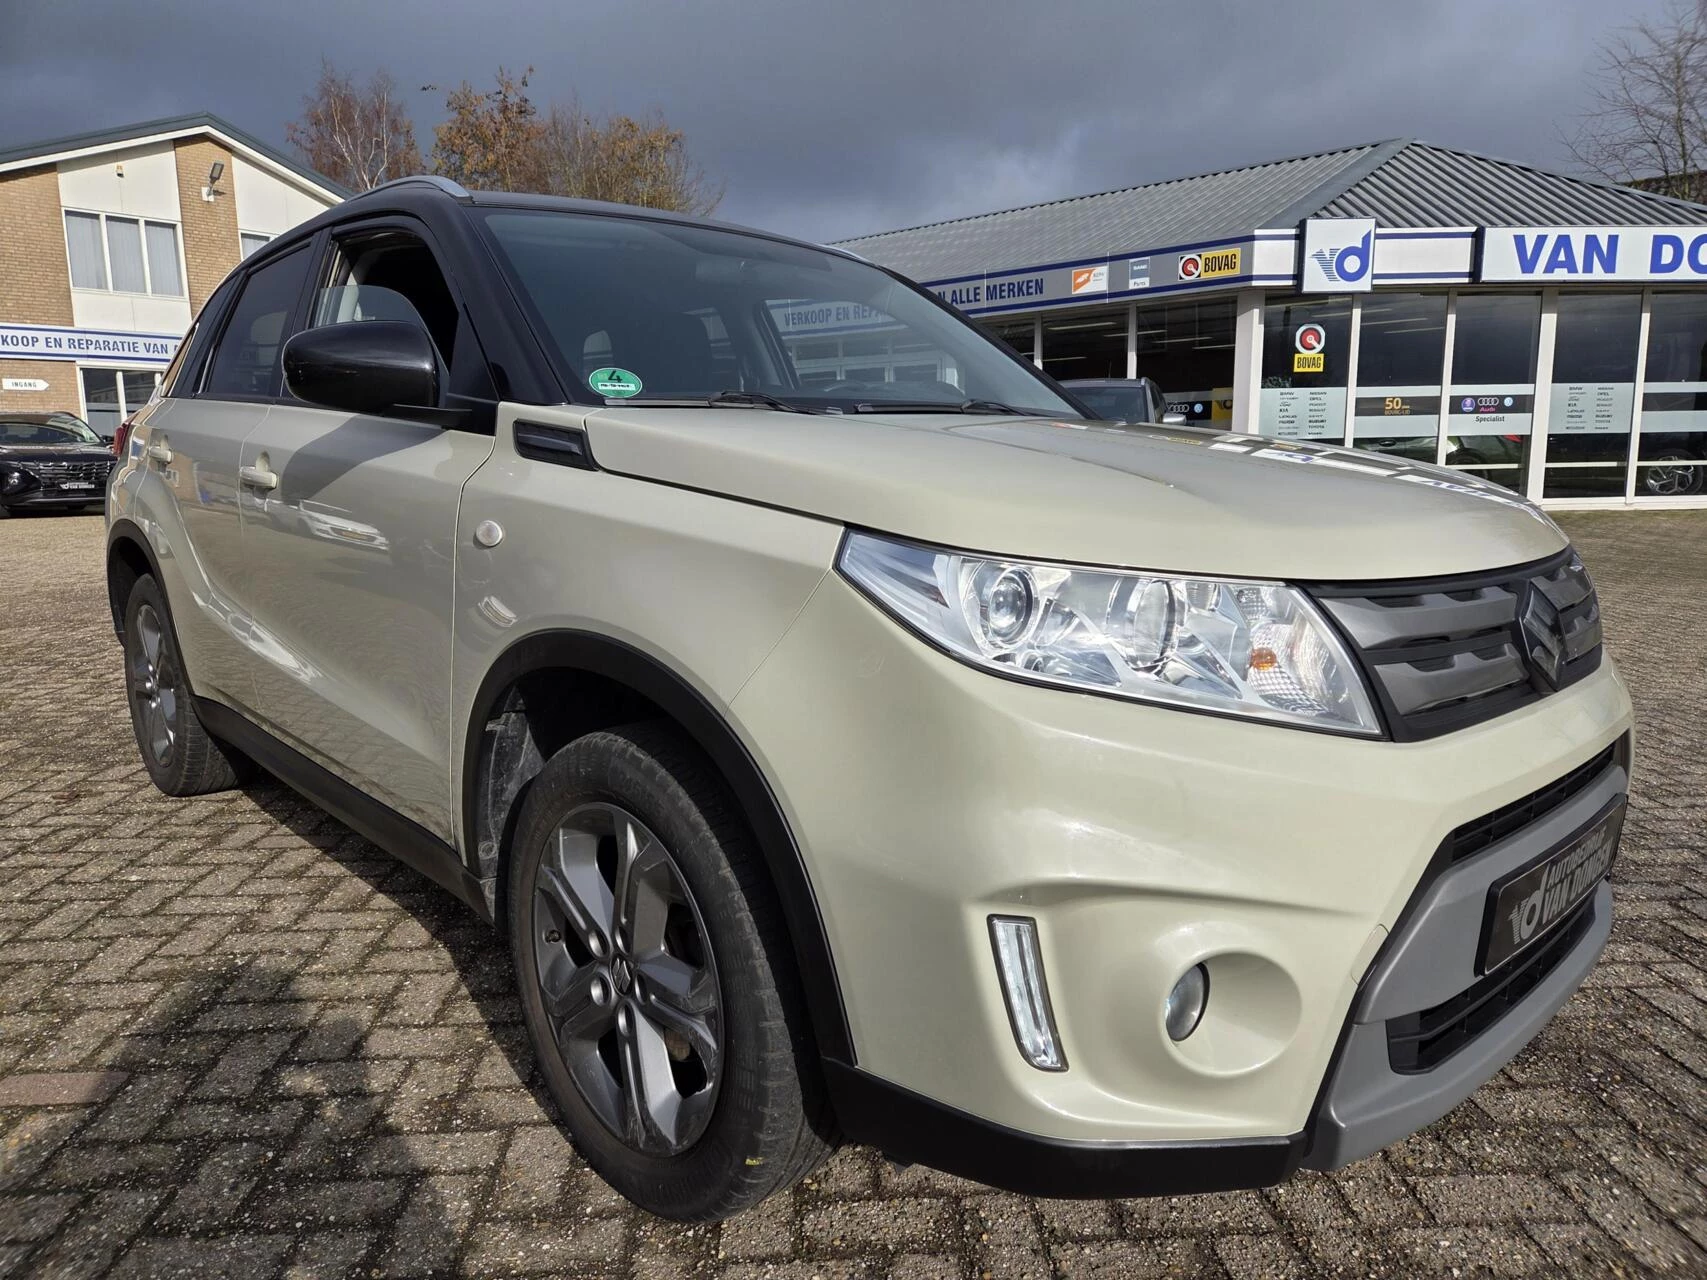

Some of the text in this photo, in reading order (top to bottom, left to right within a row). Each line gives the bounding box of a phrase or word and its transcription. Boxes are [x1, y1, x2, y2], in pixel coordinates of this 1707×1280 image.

[1204, 253, 1237, 273] BOVAG
[1512, 234, 1620, 274] VAN
[950, 286, 981, 305] ALLE
[986, 278, 1044, 301] MERKEN
[784, 308, 833, 327] VERKOOP
[836, 306, 850, 321] EN
[0, 334, 39, 348] KOOP
[45, 336, 63, 349] EN
[67, 337, 140, 353] REPARATIE
[143, 342, 169, 355] VAN
[1296, 355, 1322, 369] BOVAG
[607, 370, 623, 383] 4
[1384, 397, 1402, 410] 50
[1475, 415, 1505, 423] Specialist
[1542, 874, 1572, 925] VAN
